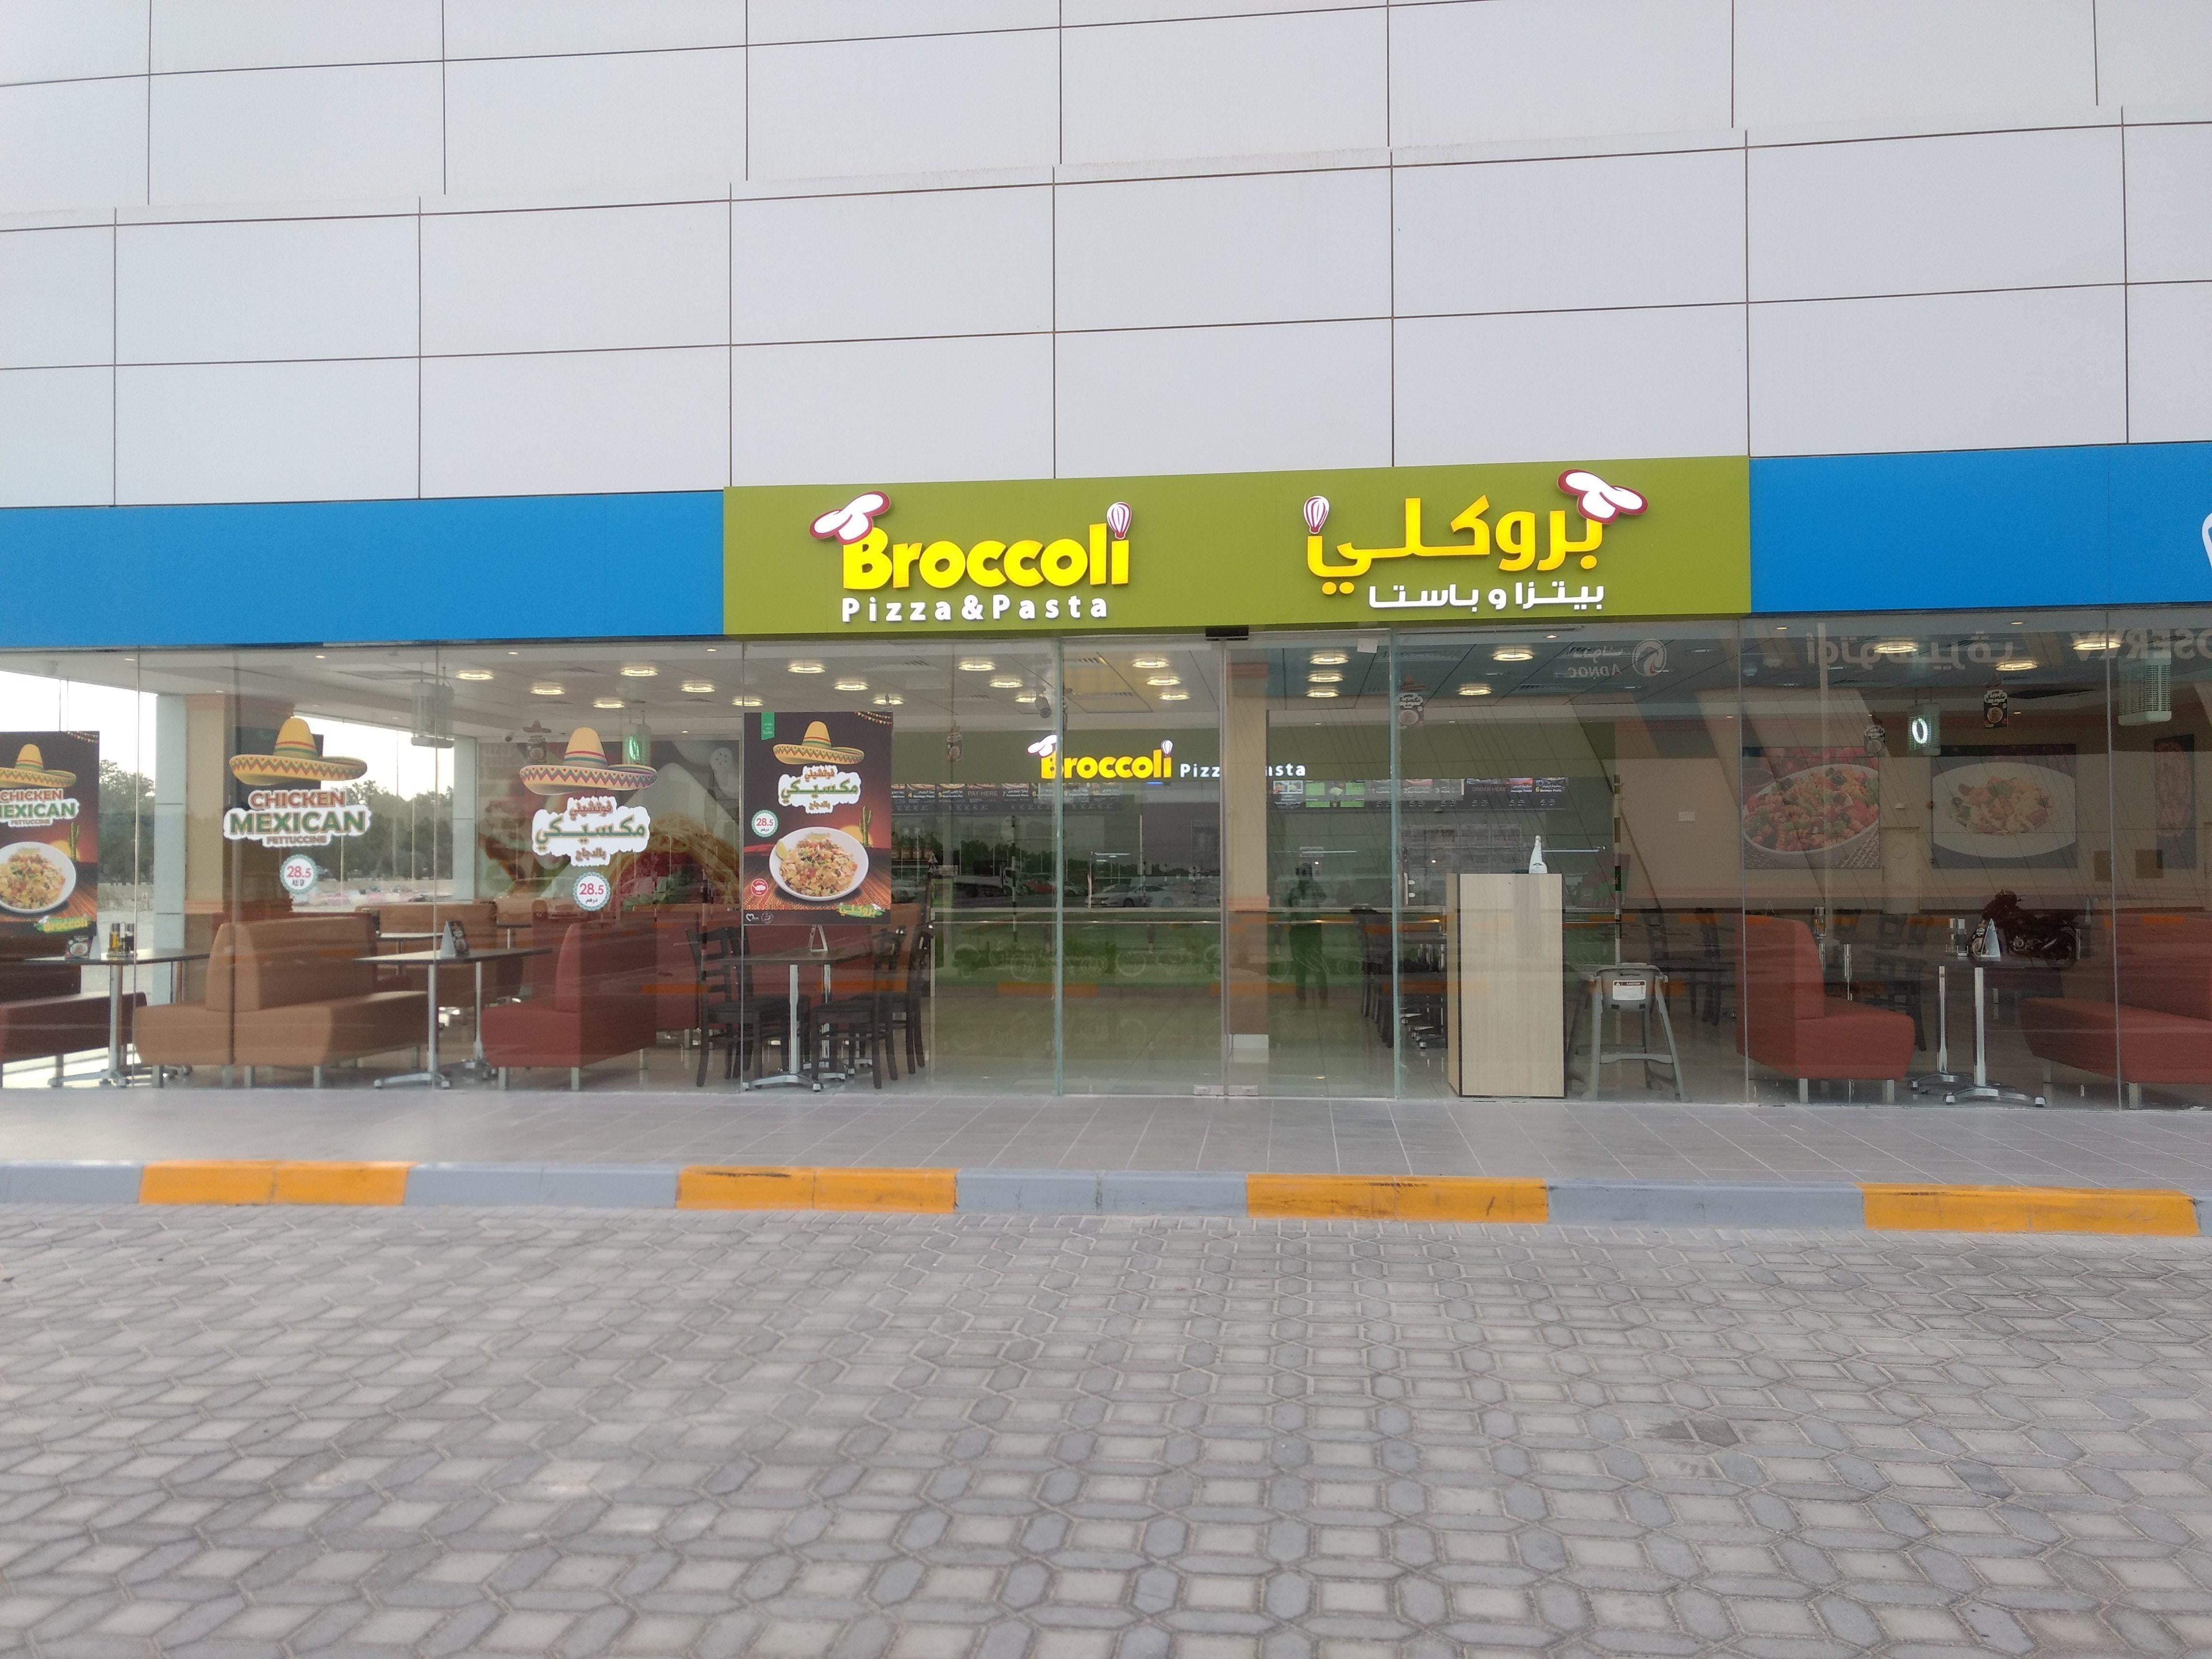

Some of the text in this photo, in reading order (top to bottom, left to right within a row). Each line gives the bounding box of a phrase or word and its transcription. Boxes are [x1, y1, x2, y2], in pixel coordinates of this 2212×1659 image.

[1307, 494, 1604, 595] بروكلي
[842, 522, 1130, 590] Broccoli
[1368, 581, 1605, 613] بيتزا و باستا
[1040, 749, 1172, 780] Broccoli
[0, 790, 62, 802] CHICKEN
[250, 791, 345, 808] CHICKEN
[781, 778, 859, 804] مكسيكي
[0, 803, 76, 818] EXICAN
[229, 810, 366, 835] MEXICAN
[756, 817, 774, 827] 28.5
[266, 835, 327, 844] FETTUCCINE
[536, 814, 646, 852] مكسيكي
[287, 866, 312, 878] 28.5
[579, 883, 604, 895] 28.5
